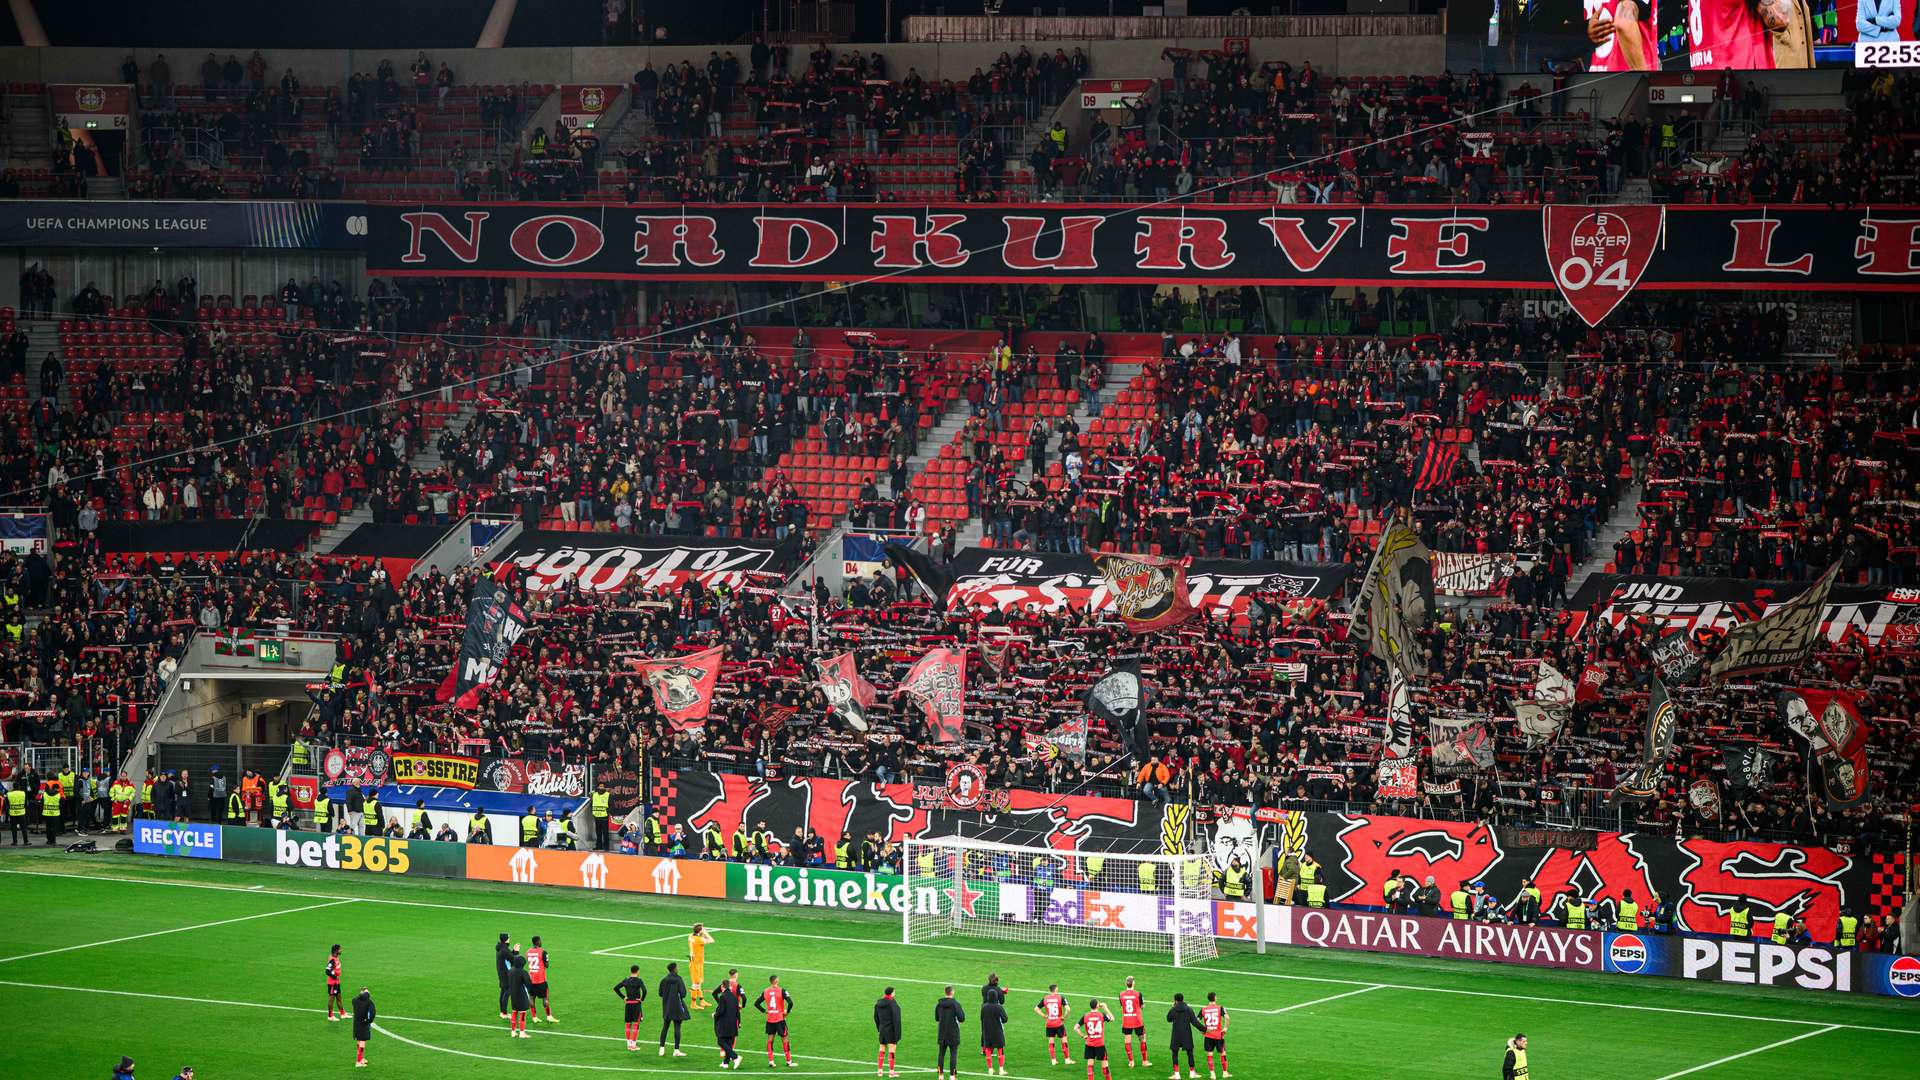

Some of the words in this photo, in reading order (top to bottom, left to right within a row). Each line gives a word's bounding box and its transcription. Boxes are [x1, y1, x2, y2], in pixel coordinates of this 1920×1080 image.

[1863, 45, 1920, 66] 22:53
[1083, 95, 1097, 107] D9
[1651, 89, 1665, 101] D8
[113, 116, 127, 128] E4
[563, 116, 578, 129] D10
[26, 217, 64, 231] UEFA
[67, 217, 150, 231] CHAMPIONS
[154, 217, 208, 231] LEAGUE
[401, 211, 1491, 275] NORDKURVE
[1574, 235, 1628, 247] BAYER
[1559, 256, 1631, 292] 04
[845, 562, 858, 575] D4
[978, 556, 1044, 575] FÜR
[771, 608, 781, 619] 27
[141, 827, 214, 849] RECYCLE
[276, 829, 410, 874] bet365
[745, 864, 940, 917] Heineken
[1157, 897, 1258, 941] FedEx
[1301, 911, 1422, 951] QATAR
[1437, 922, 1594, 965] AIRWAYS
[1611, 947, 1645, 960] PEPSI
[527, 957, 539, 970] 22
[1682, 938, 1851, 992] PEPSI
[769, 996, 777, 1010] 4
[1046, 1002, 1059, 1016] 16
[1125, 999, 1134, 1013] 8
[1204, 1012, 1219, 1026] 25
[1087, 1021, 1103, 1035] 34
